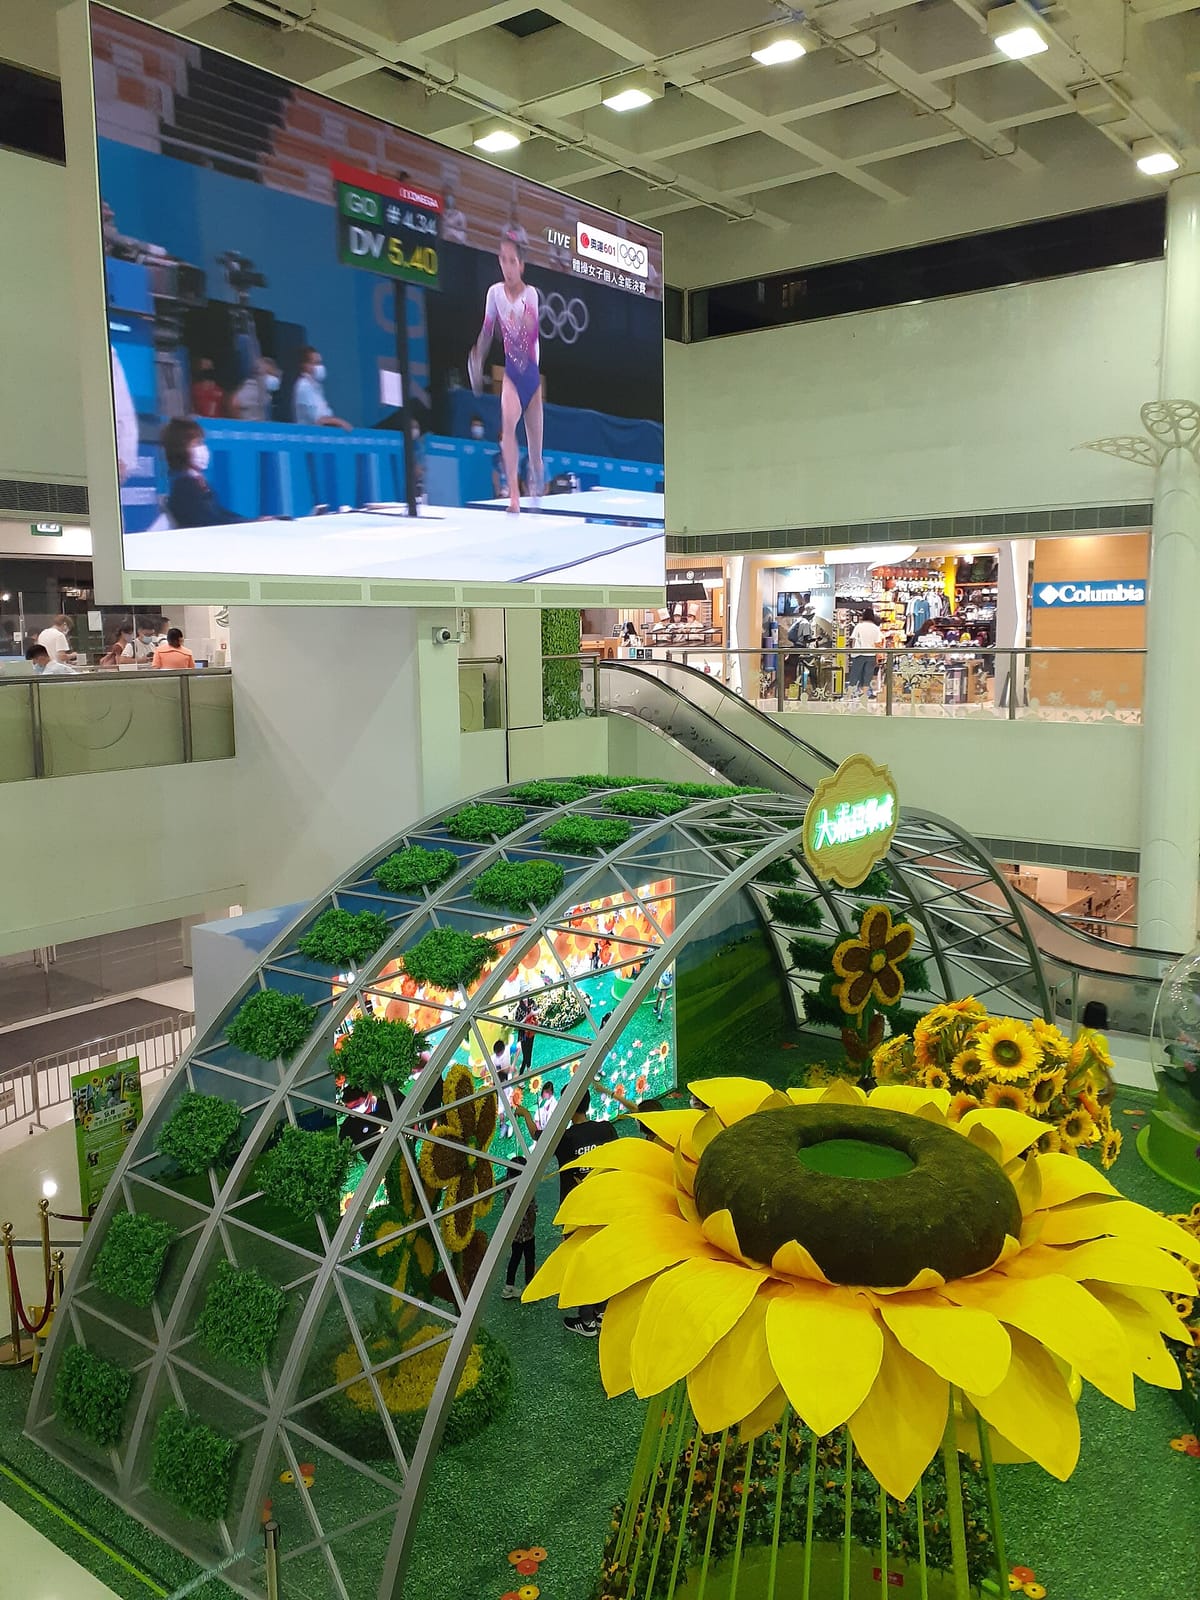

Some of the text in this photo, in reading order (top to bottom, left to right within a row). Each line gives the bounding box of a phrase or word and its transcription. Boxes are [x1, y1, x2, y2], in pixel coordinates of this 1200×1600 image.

[345, 191, 378, 218] GO
[349, 225, 438, 276] DV 5.40
[547, 229, 571, 249] LIVE
[572, 258, 647, 295] 體操女子個人全能決賽
[1058, 583, 1145, 603] Columbia
